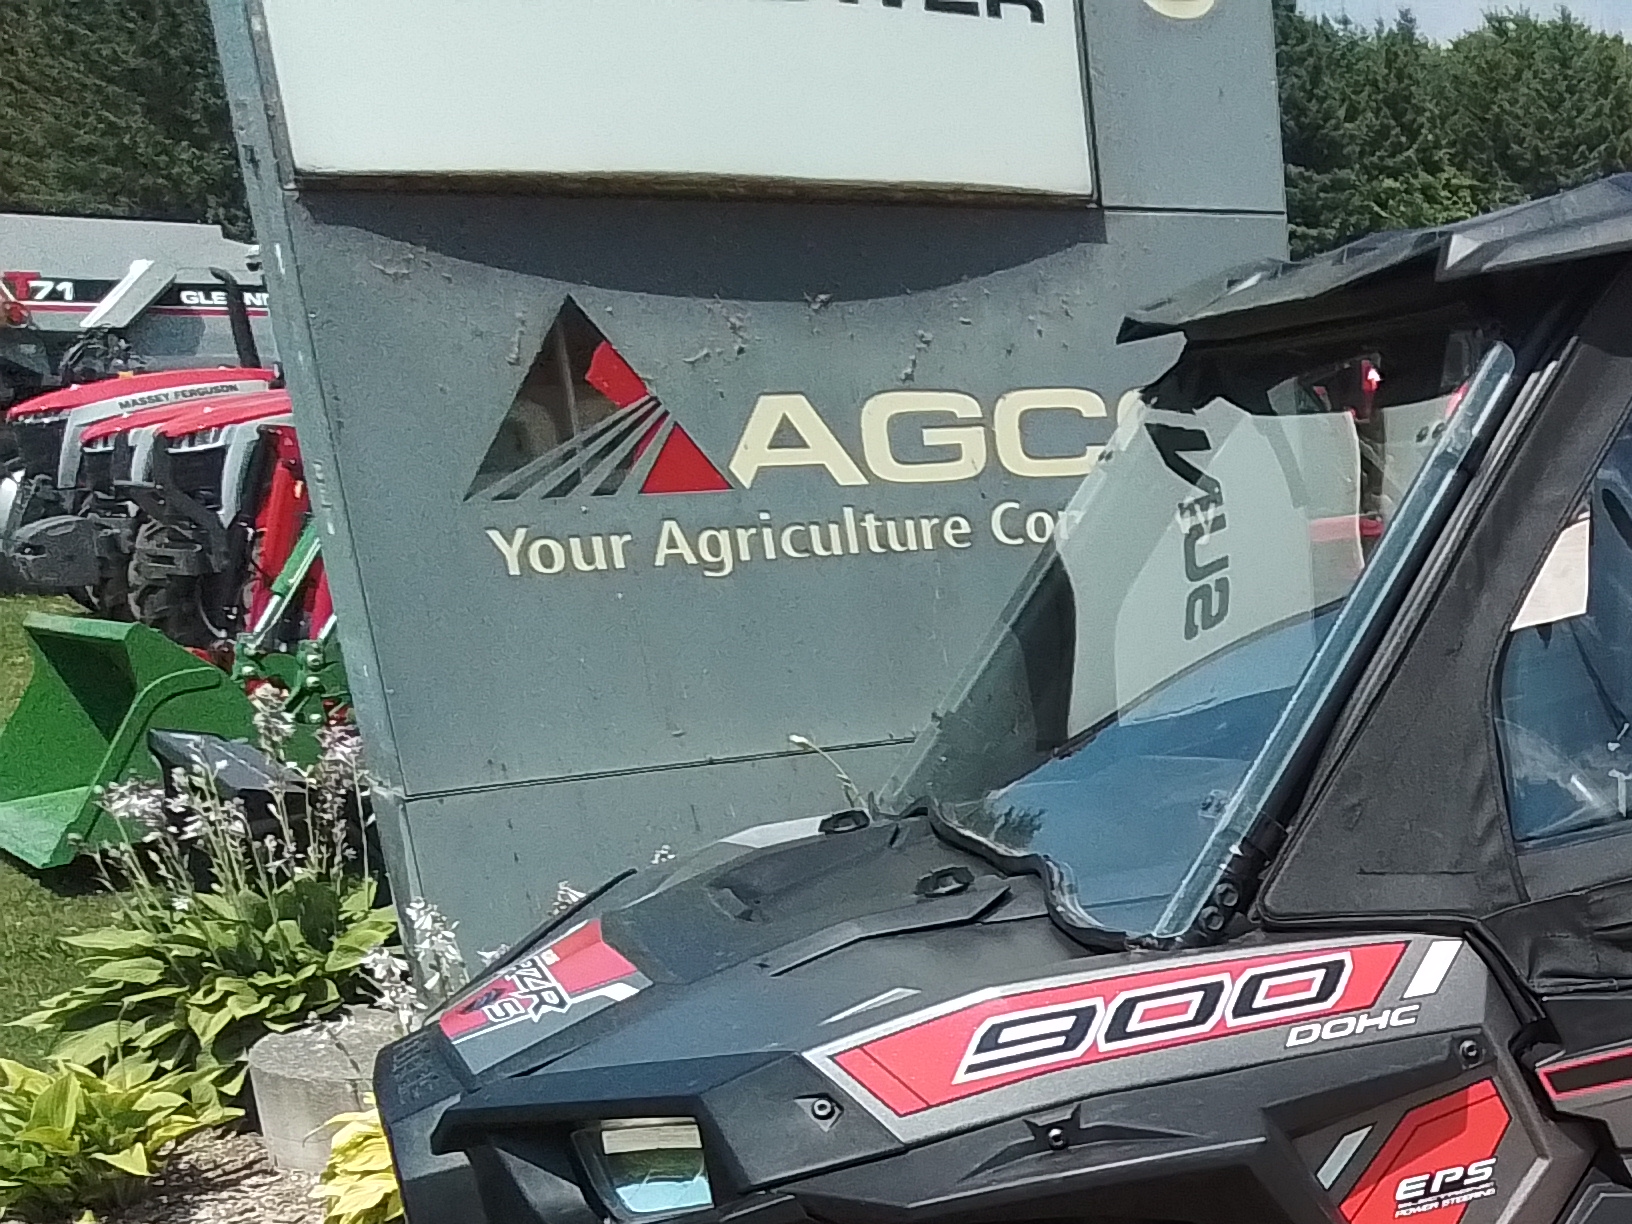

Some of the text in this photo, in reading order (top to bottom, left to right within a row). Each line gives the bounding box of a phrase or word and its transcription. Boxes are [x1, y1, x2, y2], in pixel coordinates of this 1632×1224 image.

[180, 290, 269, 306] GLEN
[118, 384, 239, 409] MASSEY FERGUSON
[486, 526, 633, 576] Your
[653, 505, 972, 578] Agriculture
[950, 951, 1353, 1085] 900
[1285, 1005, 1423, 1049] DOHC
[1395, 1157, 1497, 1201] EPS
[1395, 1187, 1496, 1218] POWER STEERING
